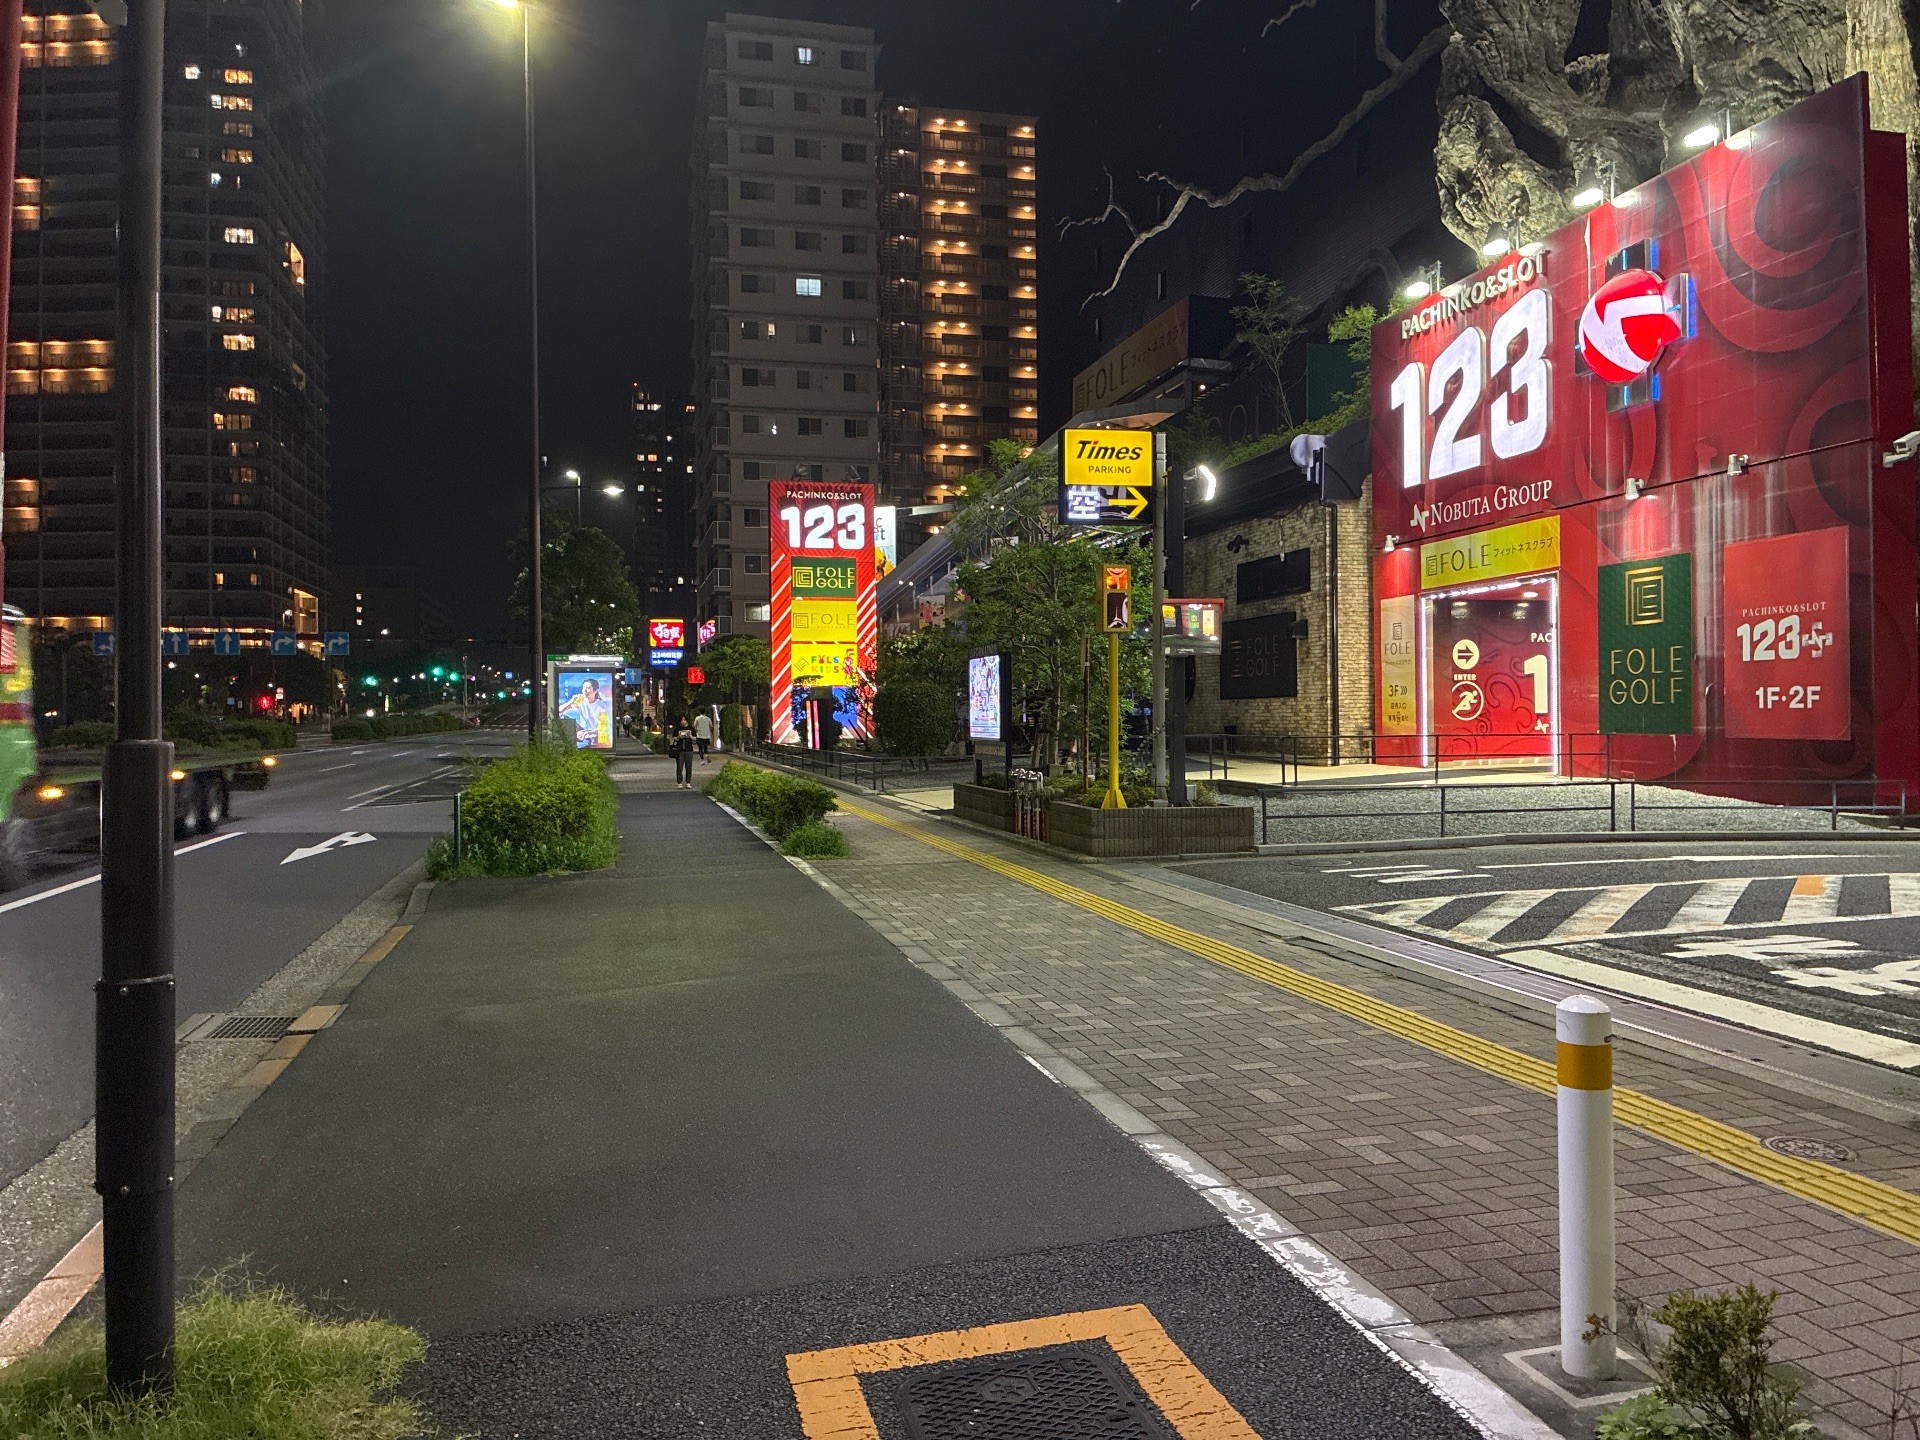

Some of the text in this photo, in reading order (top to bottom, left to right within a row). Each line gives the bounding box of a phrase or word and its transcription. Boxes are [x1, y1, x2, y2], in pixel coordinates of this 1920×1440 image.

[1402, 252, 1547, 339] PACHINKO&SLOT
[1086, 351, 1130, 409] FOLE
[1390, 289, 1553, 489] 123
[1076, 440, 1144, 460] Times
[1088, 465, 1132, 474] PARKING
[786, 490, 862, 500] PACHINKO&SLOT
[1430, 479, 1553, 525] NOBUTA GROUP
[780, 503, 865, 550] 123
[1440, 536, 1553, 575] FOLE フィットネスクラブ
[816, 566, 856, 578] FOLE
[815, 578, 856, 589] GOLF
[1742, 601, 1827, 617] PACHINKO&SLOT
[810, 613, 856, 626] FOLE
[1384, 641, 1411, 656] FOLE
[1736, 615, 1801, 662] 123
[811, 665, 839, 674] KIDS
[1610, 646, 1684, 675] FOLE
[1388, 684, 1399, 697] 3F
[1609, 677, 1684, 705] GOLF
